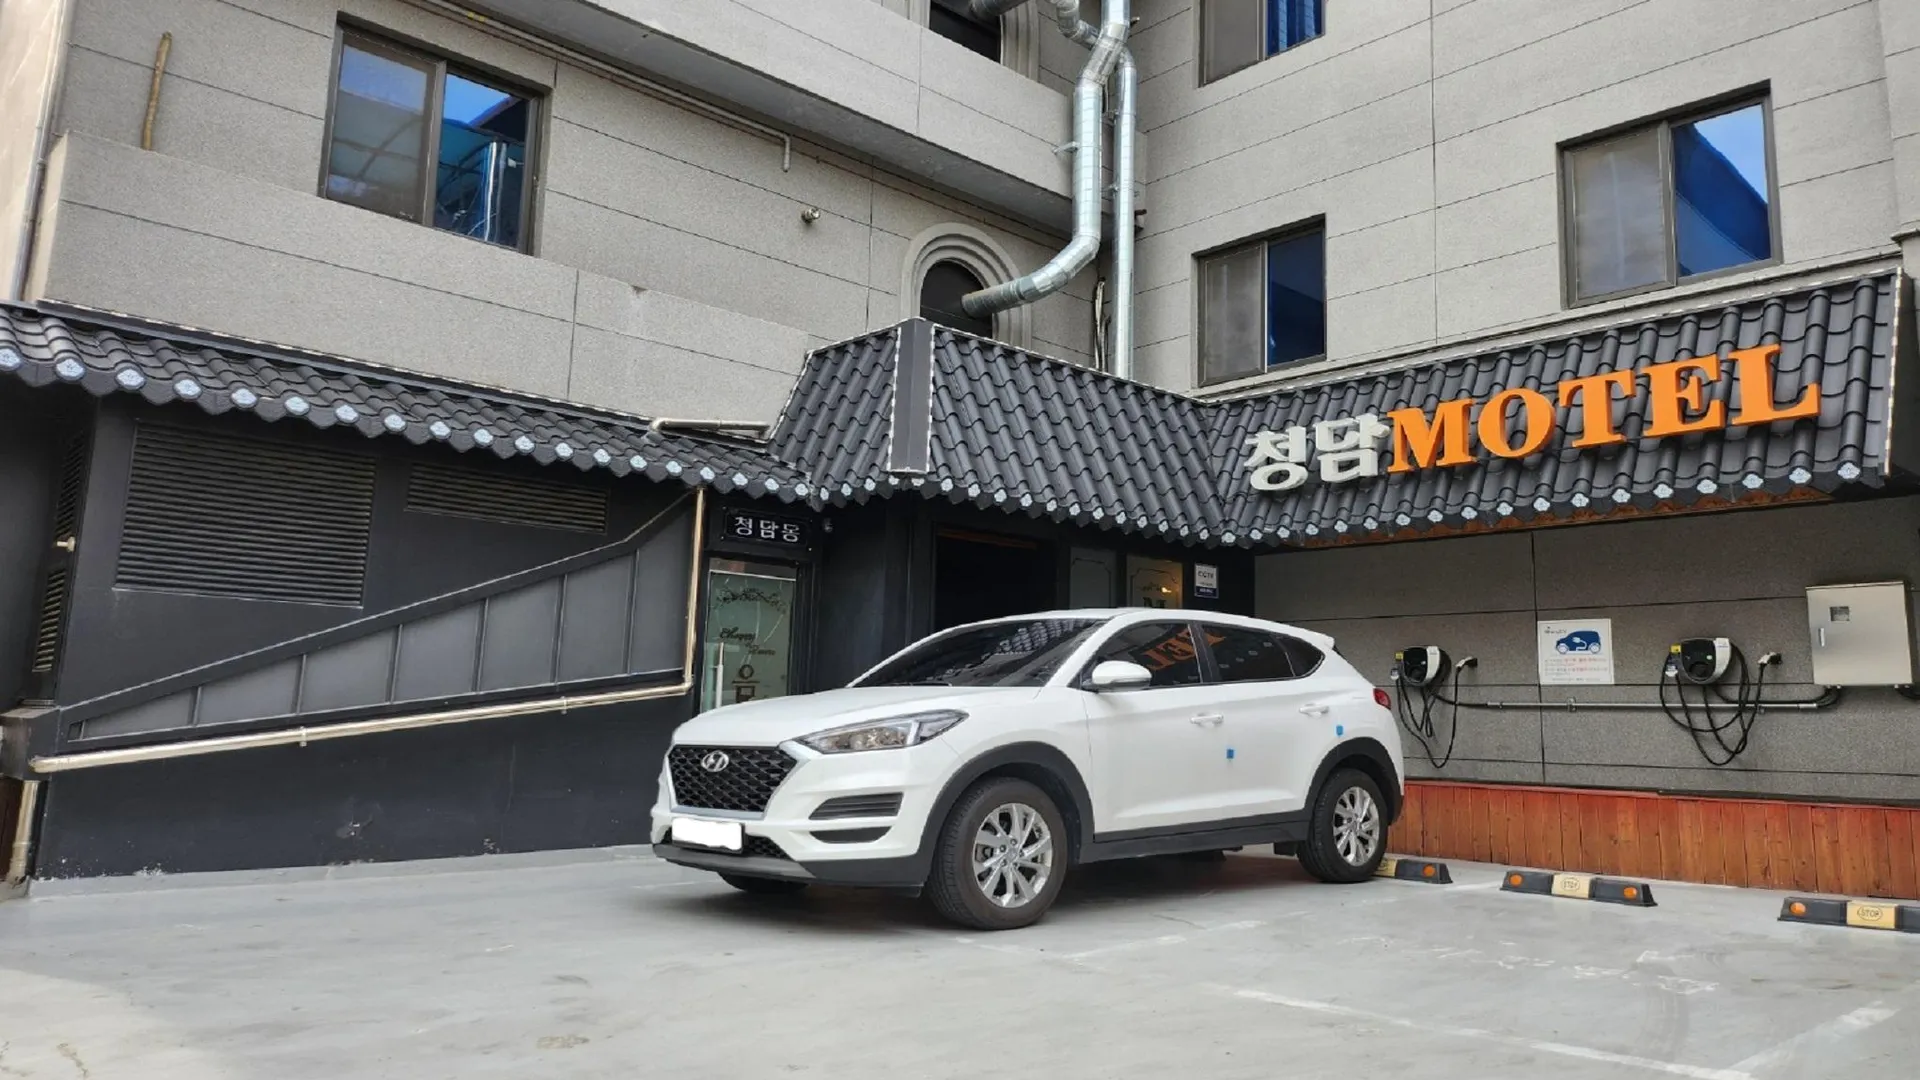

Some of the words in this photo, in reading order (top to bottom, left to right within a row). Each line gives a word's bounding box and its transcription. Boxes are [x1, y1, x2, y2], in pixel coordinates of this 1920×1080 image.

[1244, 412, 1391, 492] 청담
[1386, 344, 1821, 474] MOTEL
[734, 516, 801, 543] 청담동
